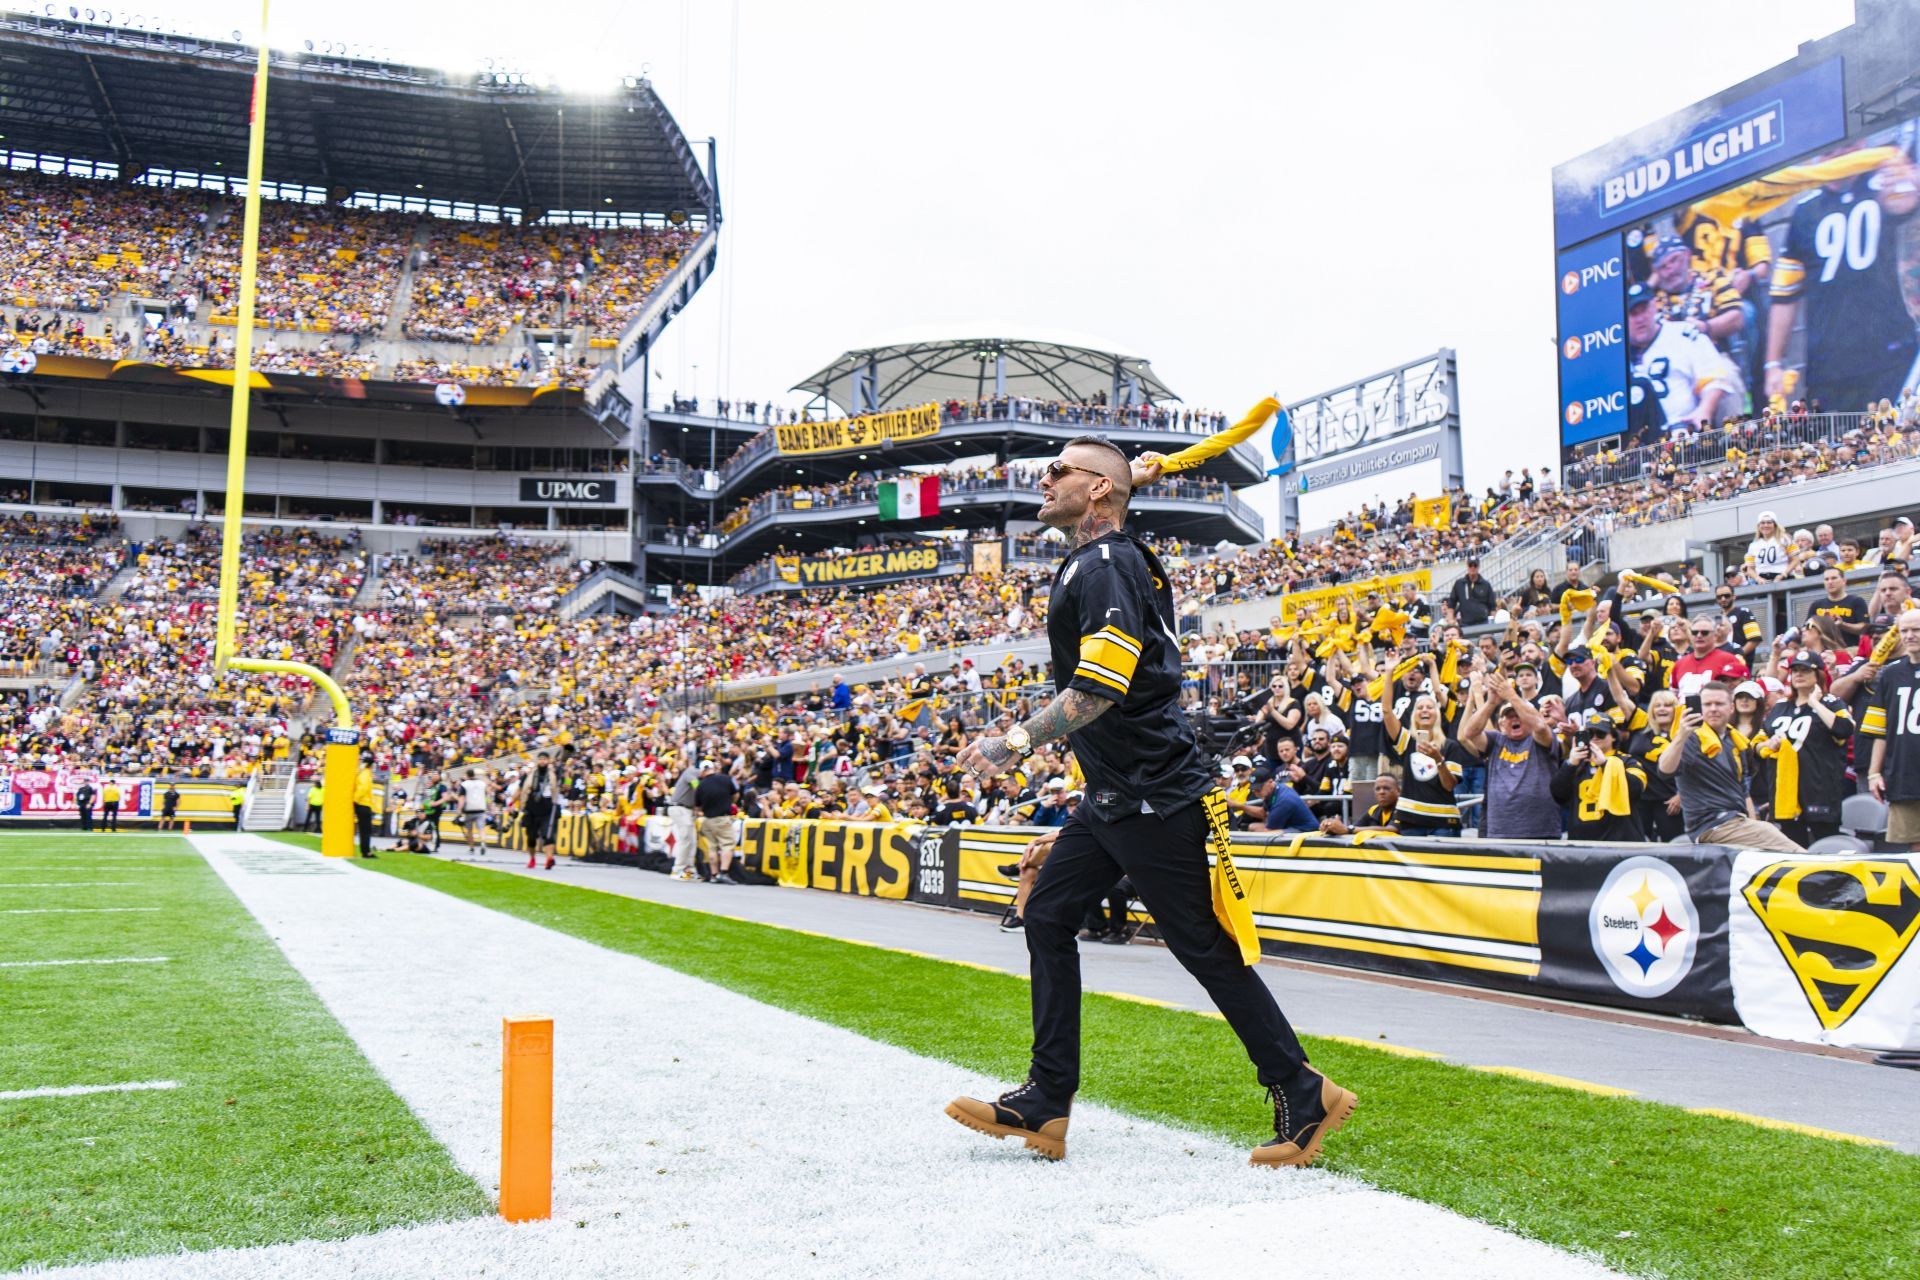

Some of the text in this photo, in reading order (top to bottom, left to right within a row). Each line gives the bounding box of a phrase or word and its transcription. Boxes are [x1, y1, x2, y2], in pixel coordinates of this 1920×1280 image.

[1604, 111, 1776, 209] BUD LIGHT
[1814, 200, 1881, 283] 90
[1581, 258, 1620, 287] PNC
[1583, 325, 1622, 352] PNC
[1585, 391, 1624, 418] PNC
[779, 428, 810, 450] BANG
[812, 423, 842, 448] BANG
[911, 408, 937, 434] GANG
[1308, 465, 1349, 488] Essential
[1350, 458, 1388, 477] Utilities
[1389, 441, 1439, 465] Company
[537, 482, 600, 499] UPMC
[1098, 544, 1110, 560] 1
[1758, 546, 1776, 564] 90
[801, 554, 886, 582] YINZER
[1354, 699, 1384, 722] 58
[919, 838, 944, 867] EST.
[919, 869, 944, 895] 1933
[1222, 861, 1242, 894] MYRON
[1603, 915, 1639, 931] Steelers
